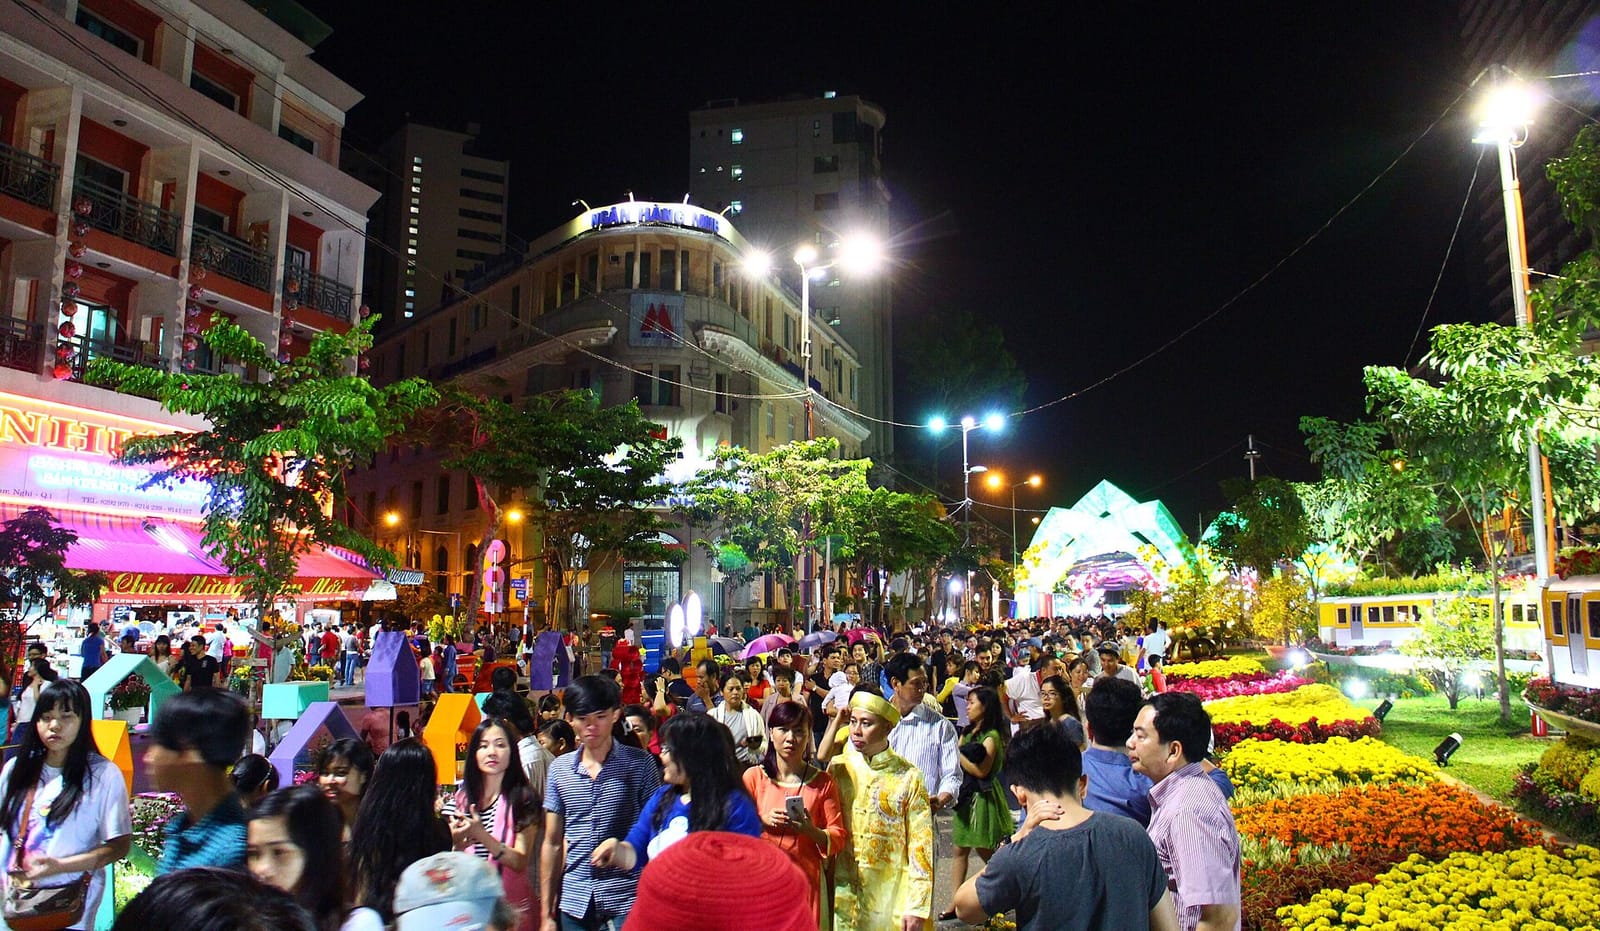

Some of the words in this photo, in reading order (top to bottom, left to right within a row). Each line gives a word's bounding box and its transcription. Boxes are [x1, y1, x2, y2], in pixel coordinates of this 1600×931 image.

[113, 572, 174, 595] Chúc
[177, 575, 244, 599] Mừng
[305, 577, 346, 594] Mới
